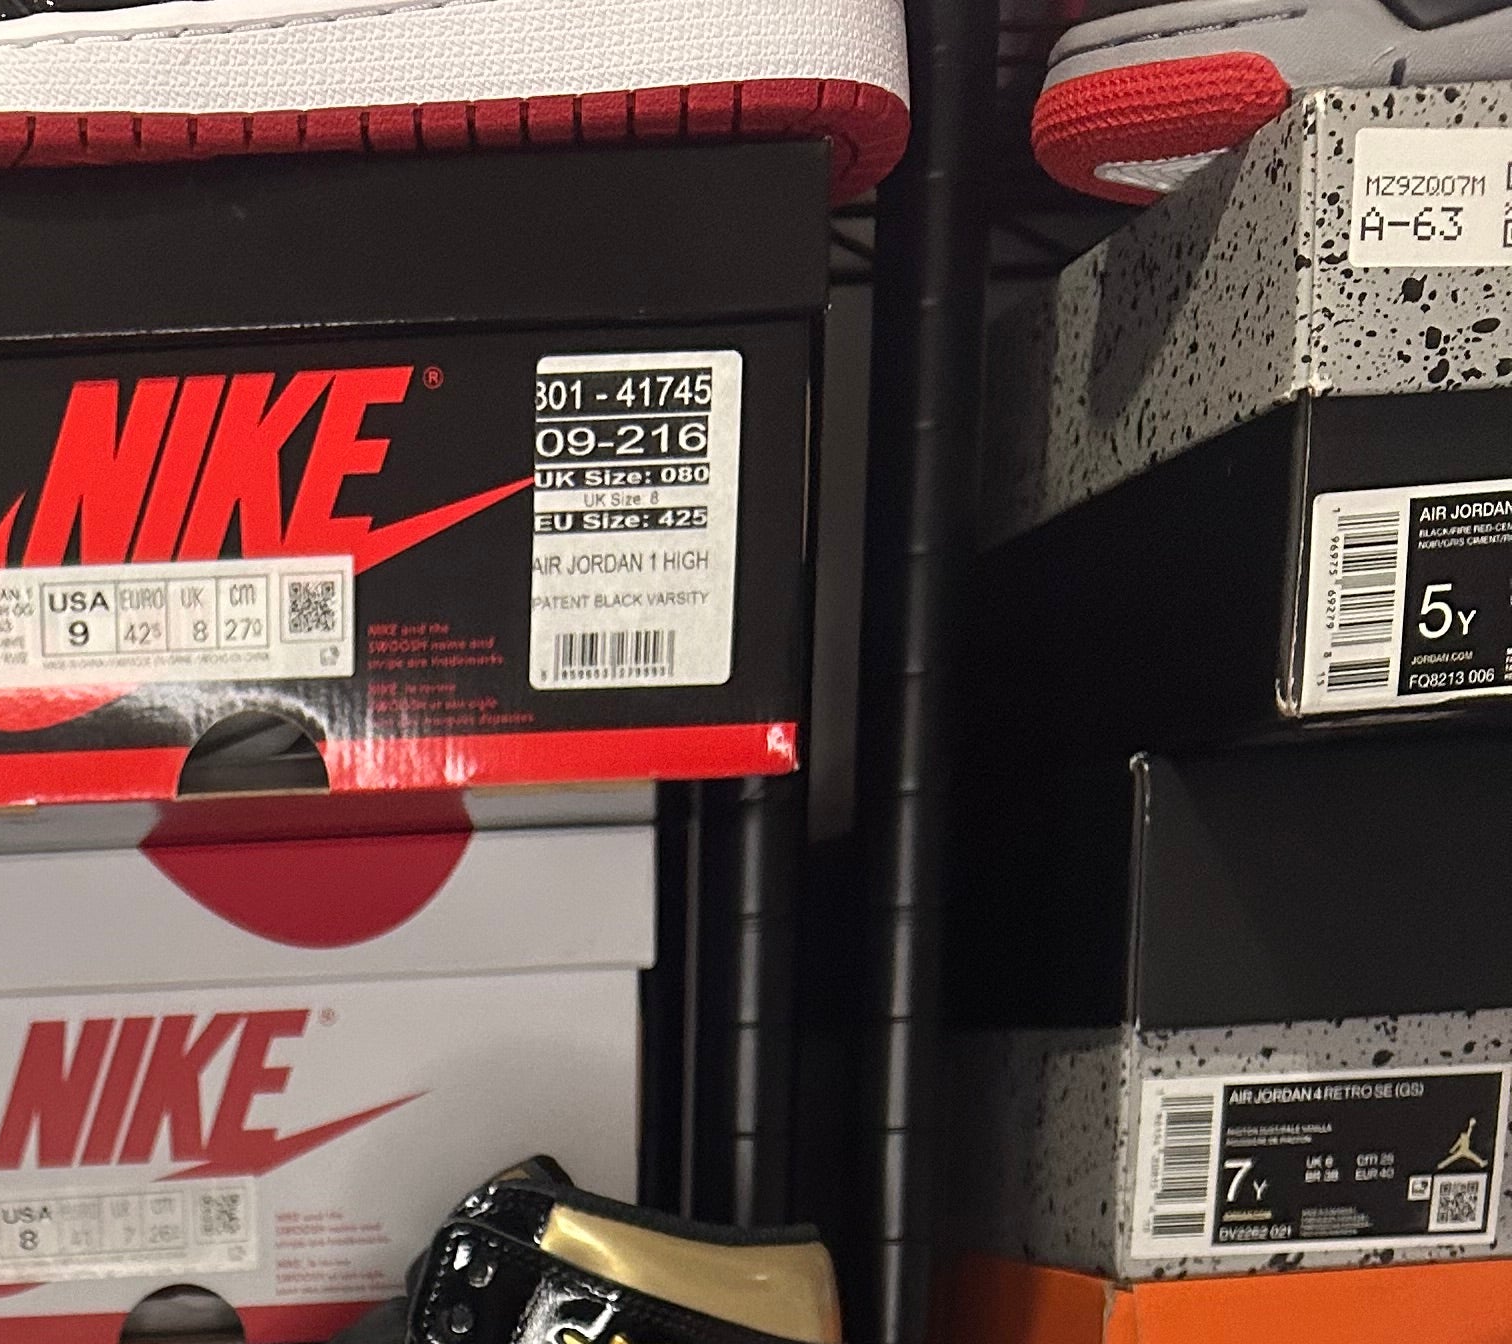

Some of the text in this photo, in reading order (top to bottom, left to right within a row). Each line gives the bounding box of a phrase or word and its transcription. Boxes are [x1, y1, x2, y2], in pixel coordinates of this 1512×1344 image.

[1360, 206, 1464, 241] A-63
[616, 374, 712, 407] 41745
[536, 422, 708, 457] 09-216
[23, 366, 414, 567] NIKE
[535, 465, 710, 488] UK Size: 080
[583, 492, 606, 508] UK
[649, 490, 660, 506] 8
[535, 509, 707, 533] EU Size: 425
[1419, 505, 1447, 522] AIR
[533, 550, 709, 576] AIR JORDAN 1 HIGH
[48, 586, 203, 614] USA EURO UK
[533, 590, 710, 611] PATENT BLACK VARSITY
[67, 620, 90, 647] 9
[192, 620, 210, 642] 8
[1408, 667, 1495, 690] FQ8213 006
[1229, 1087, 1253, 1105] AIR
[1254, 1086, 1313, 1105] JORDAN
[1324, 1083, 1374, 1100] RETRO
[1305, 1155, 1323, 1169] UK
[2, 1206, 54, 1225] USA
[19, 1230, 39, 1251] 8
